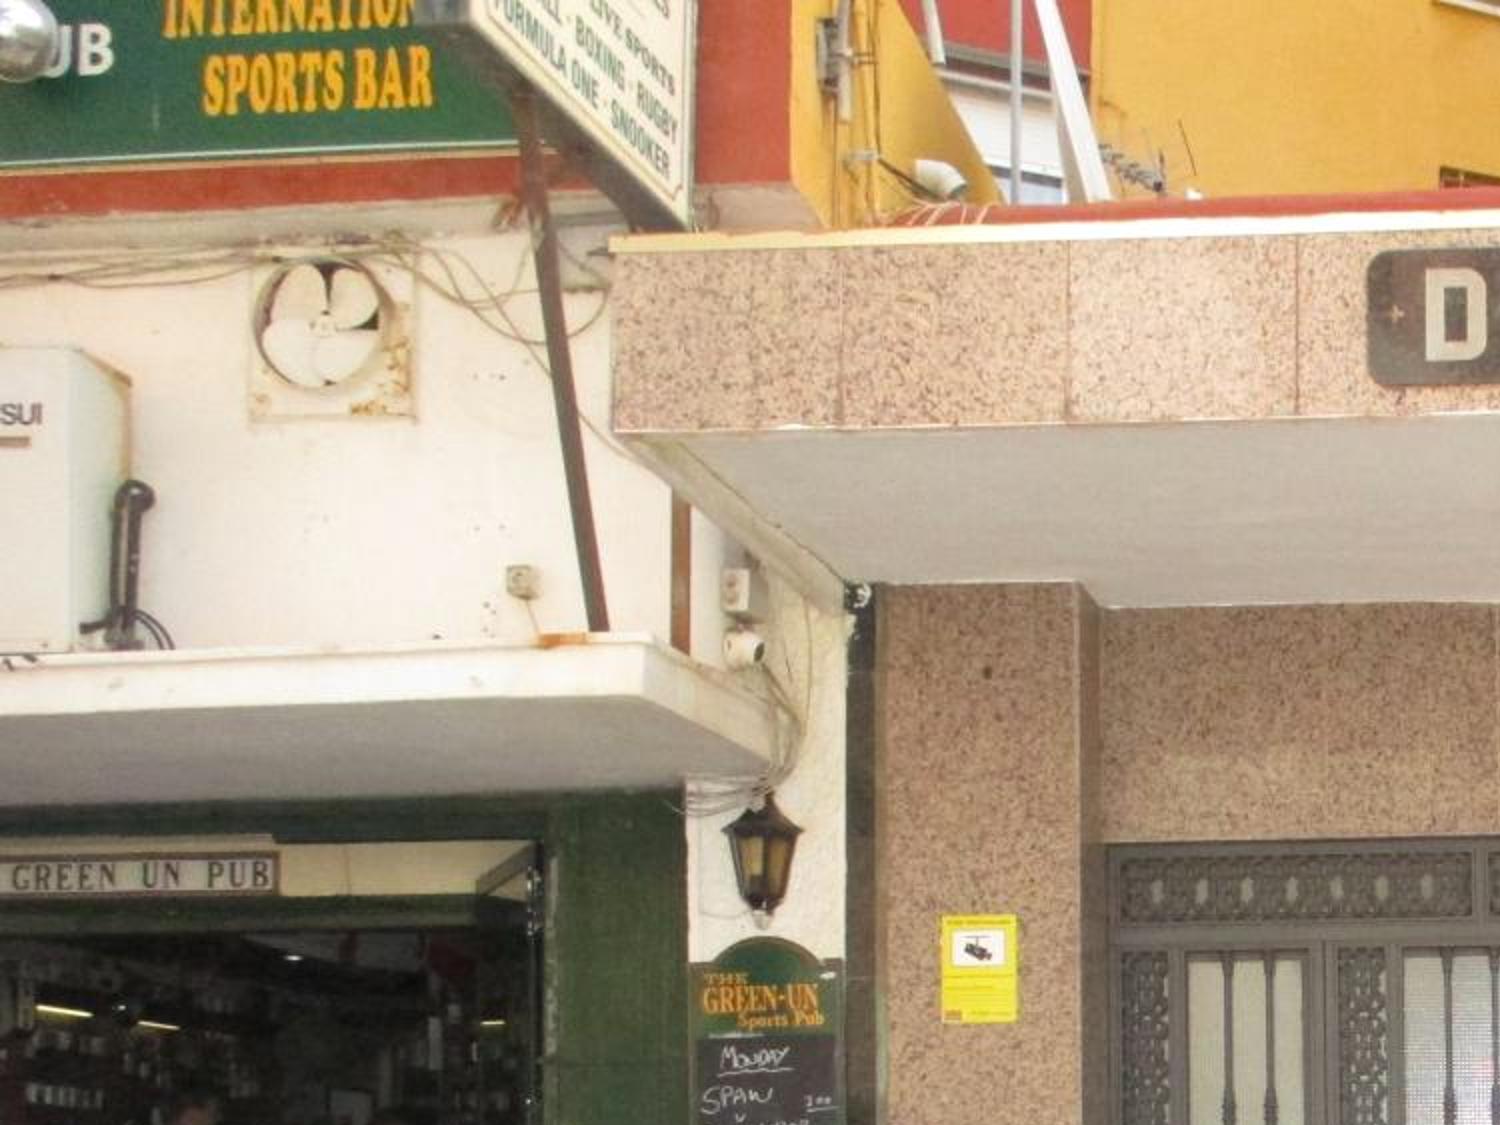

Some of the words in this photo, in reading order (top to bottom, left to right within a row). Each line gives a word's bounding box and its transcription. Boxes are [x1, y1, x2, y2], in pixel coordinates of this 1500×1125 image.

[203, 50, 345, 116] SPORTS
[352, 45, 433, 109] BAR
[575, 15, 625, 92] BOXING
[636, 81, 678, 144] RUGBY
[625, 27, 675, 96] SPORTS
[570, 58, 598, 110] ONE
[610, 98, 670, 180] SNOOKER
[11, 862, 116, 890] GREEN
[142, 861, 180, 889] UN
[207, 860, 269, 888] PUB
[704, 972, 748, 985] THE
[795, 1008, 824, 1026] Pub
[719, 1045, 790, 1070] MONDAY
